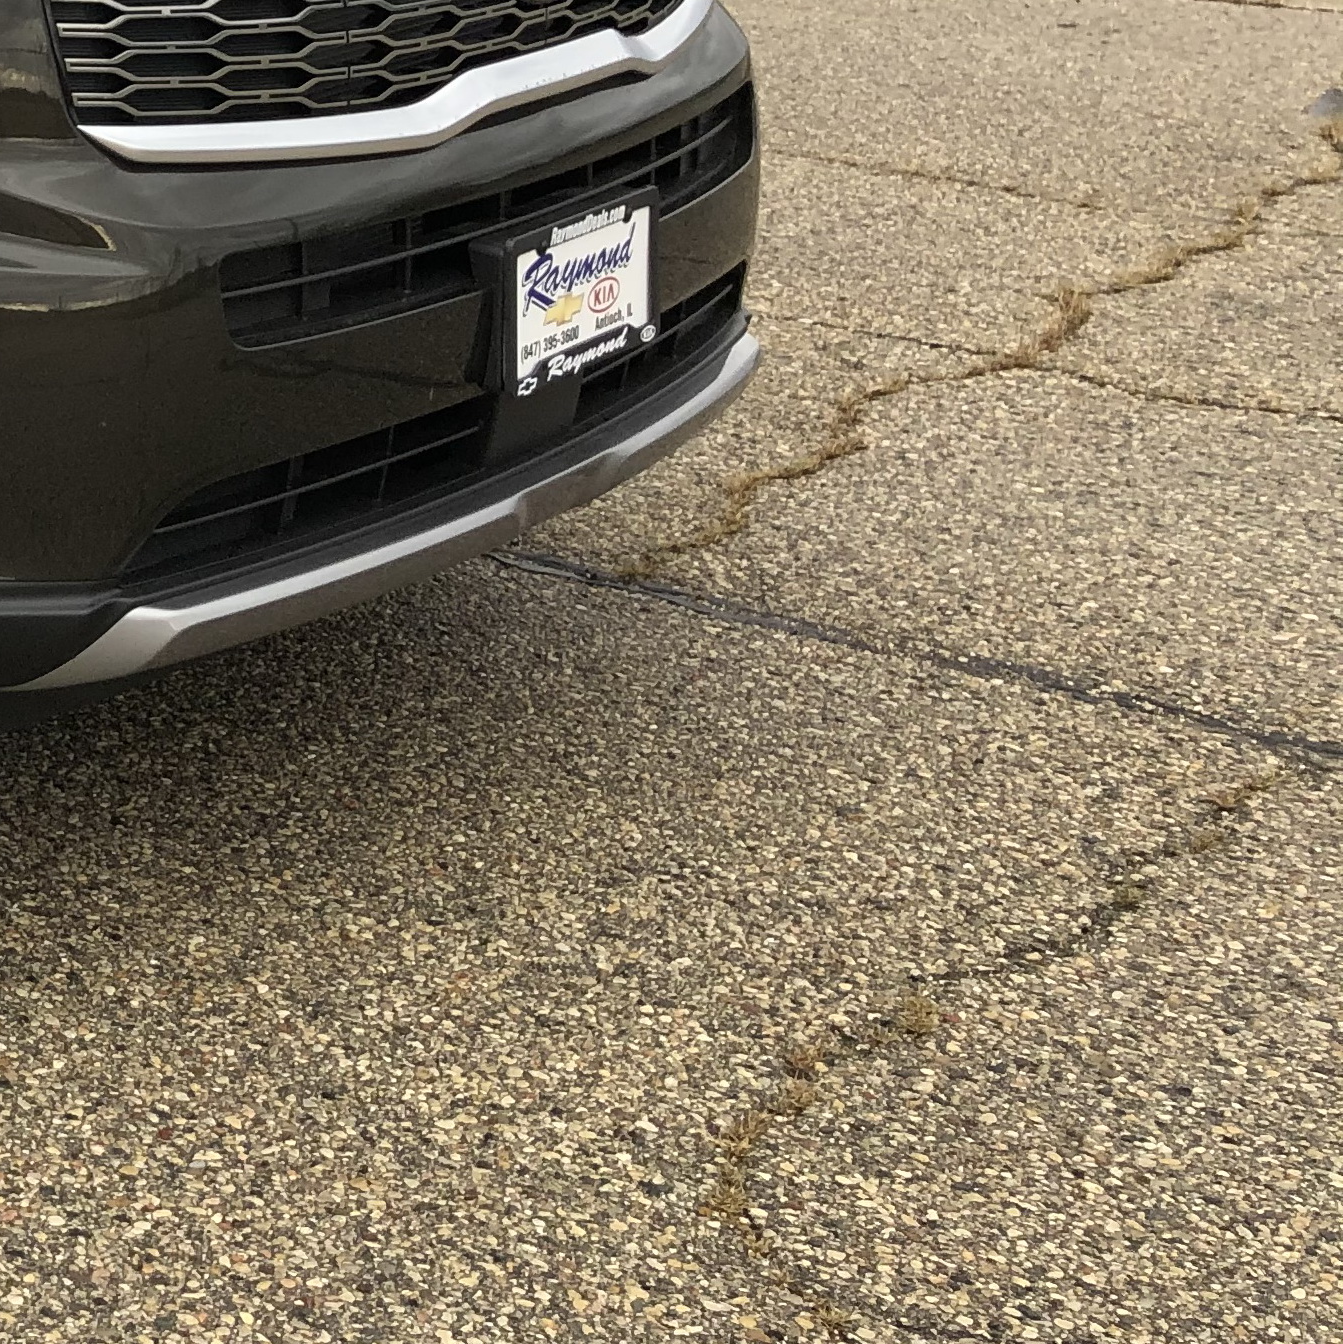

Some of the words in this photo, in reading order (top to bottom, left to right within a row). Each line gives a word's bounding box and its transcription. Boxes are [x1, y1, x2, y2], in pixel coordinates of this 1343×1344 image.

[521, 221, 636, 317] Raymond
[593, 282, 614, 307] KIA
[521, 340, 541, 365] (847)
[543, 324, 579, 353] 395-3600
[547, 326, 628, 382] Raymond
